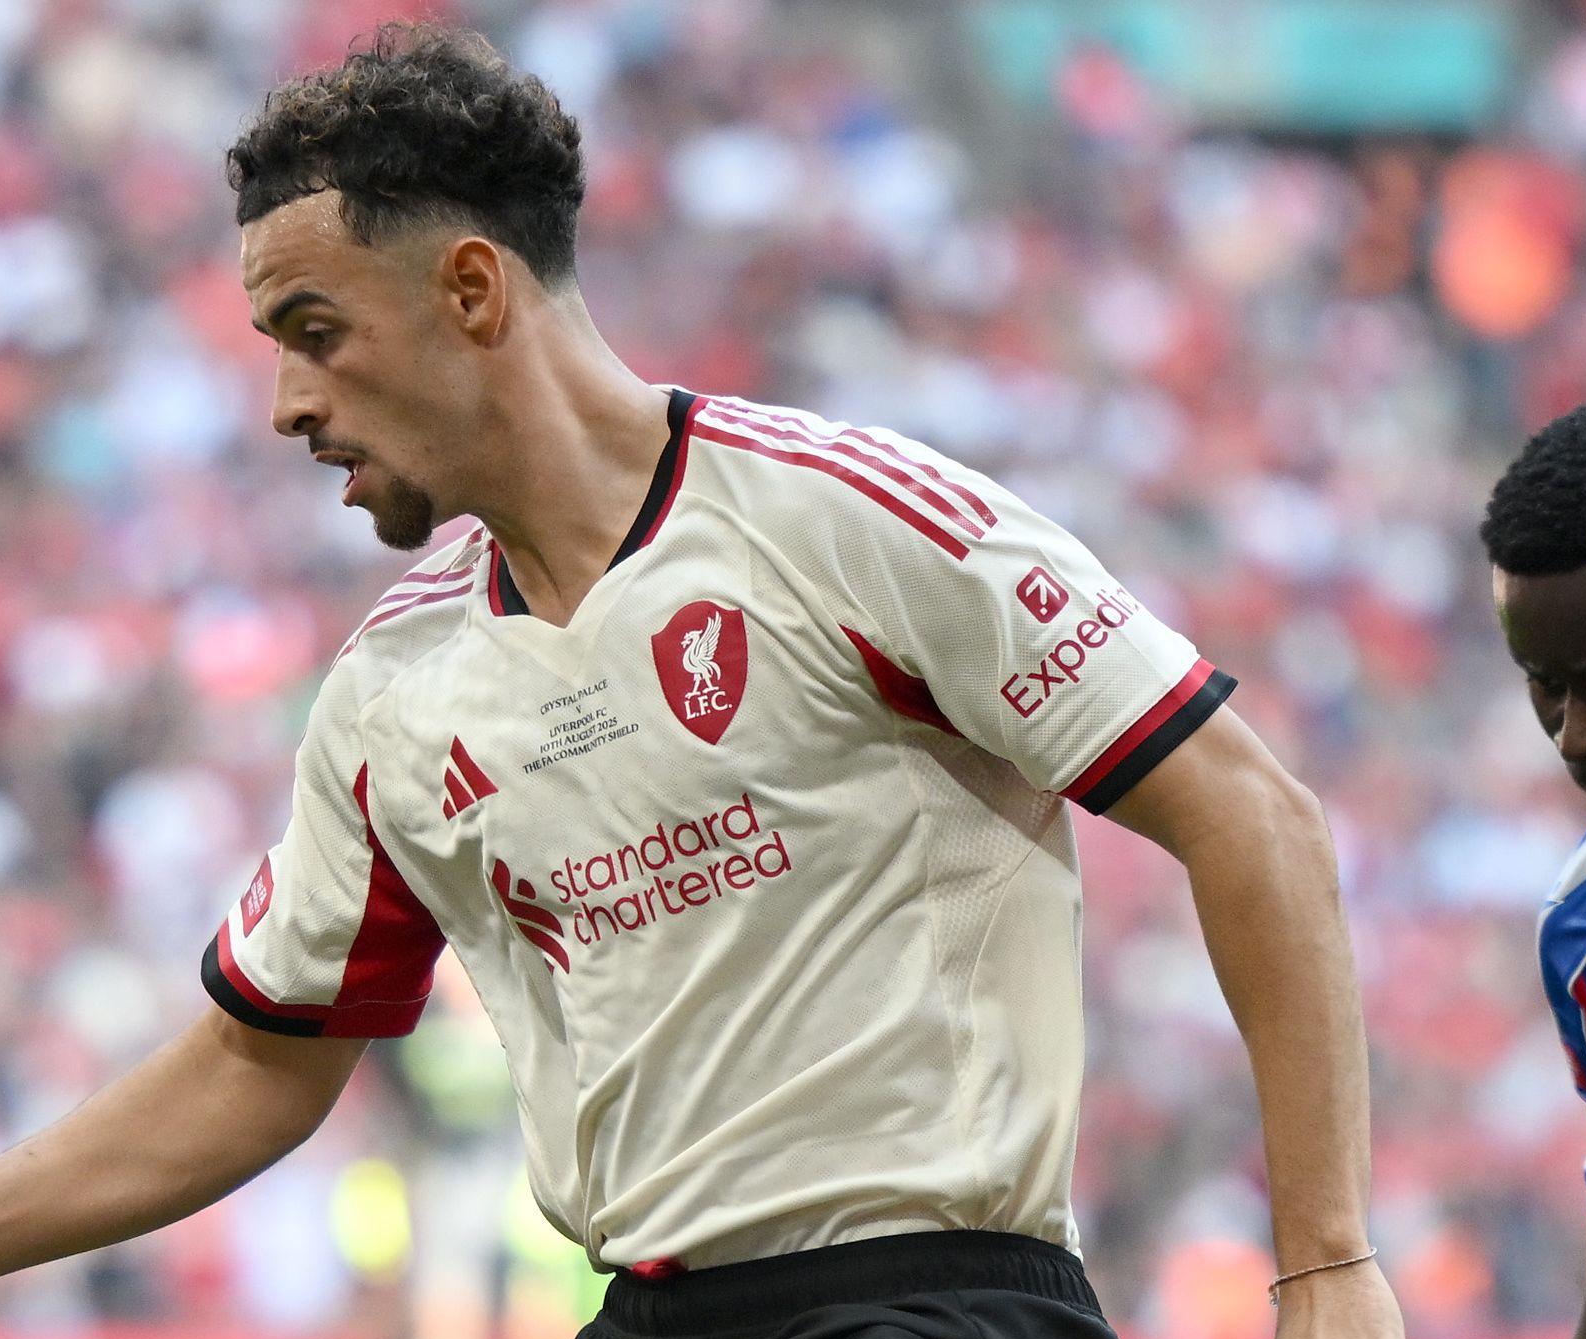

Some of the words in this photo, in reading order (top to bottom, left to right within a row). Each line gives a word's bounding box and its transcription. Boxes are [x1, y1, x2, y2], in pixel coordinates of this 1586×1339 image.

[540, 694, 577, 715] CRYSTAL
[577, 679, 608, 700] PALACE
[684, 691, 733, 720] L.F.C.
[540, 738, 563, 753] 10TH
[563, 726, 597, 745] AUGUST
[597, 717, 618, 732] 2025
[549, 712, 595, 738] LIVERPOOL
[595, 707, 607, 719] FC
[522, 760, 542, 774] THE
[542, 756, 553, 767] FA
[553, 735, 607, 762] COMMUNITY
[607, 723, 639, 742] SHIELD
[550, 792, 760, 904] standard
[573, 831, 792, 945] chartered
